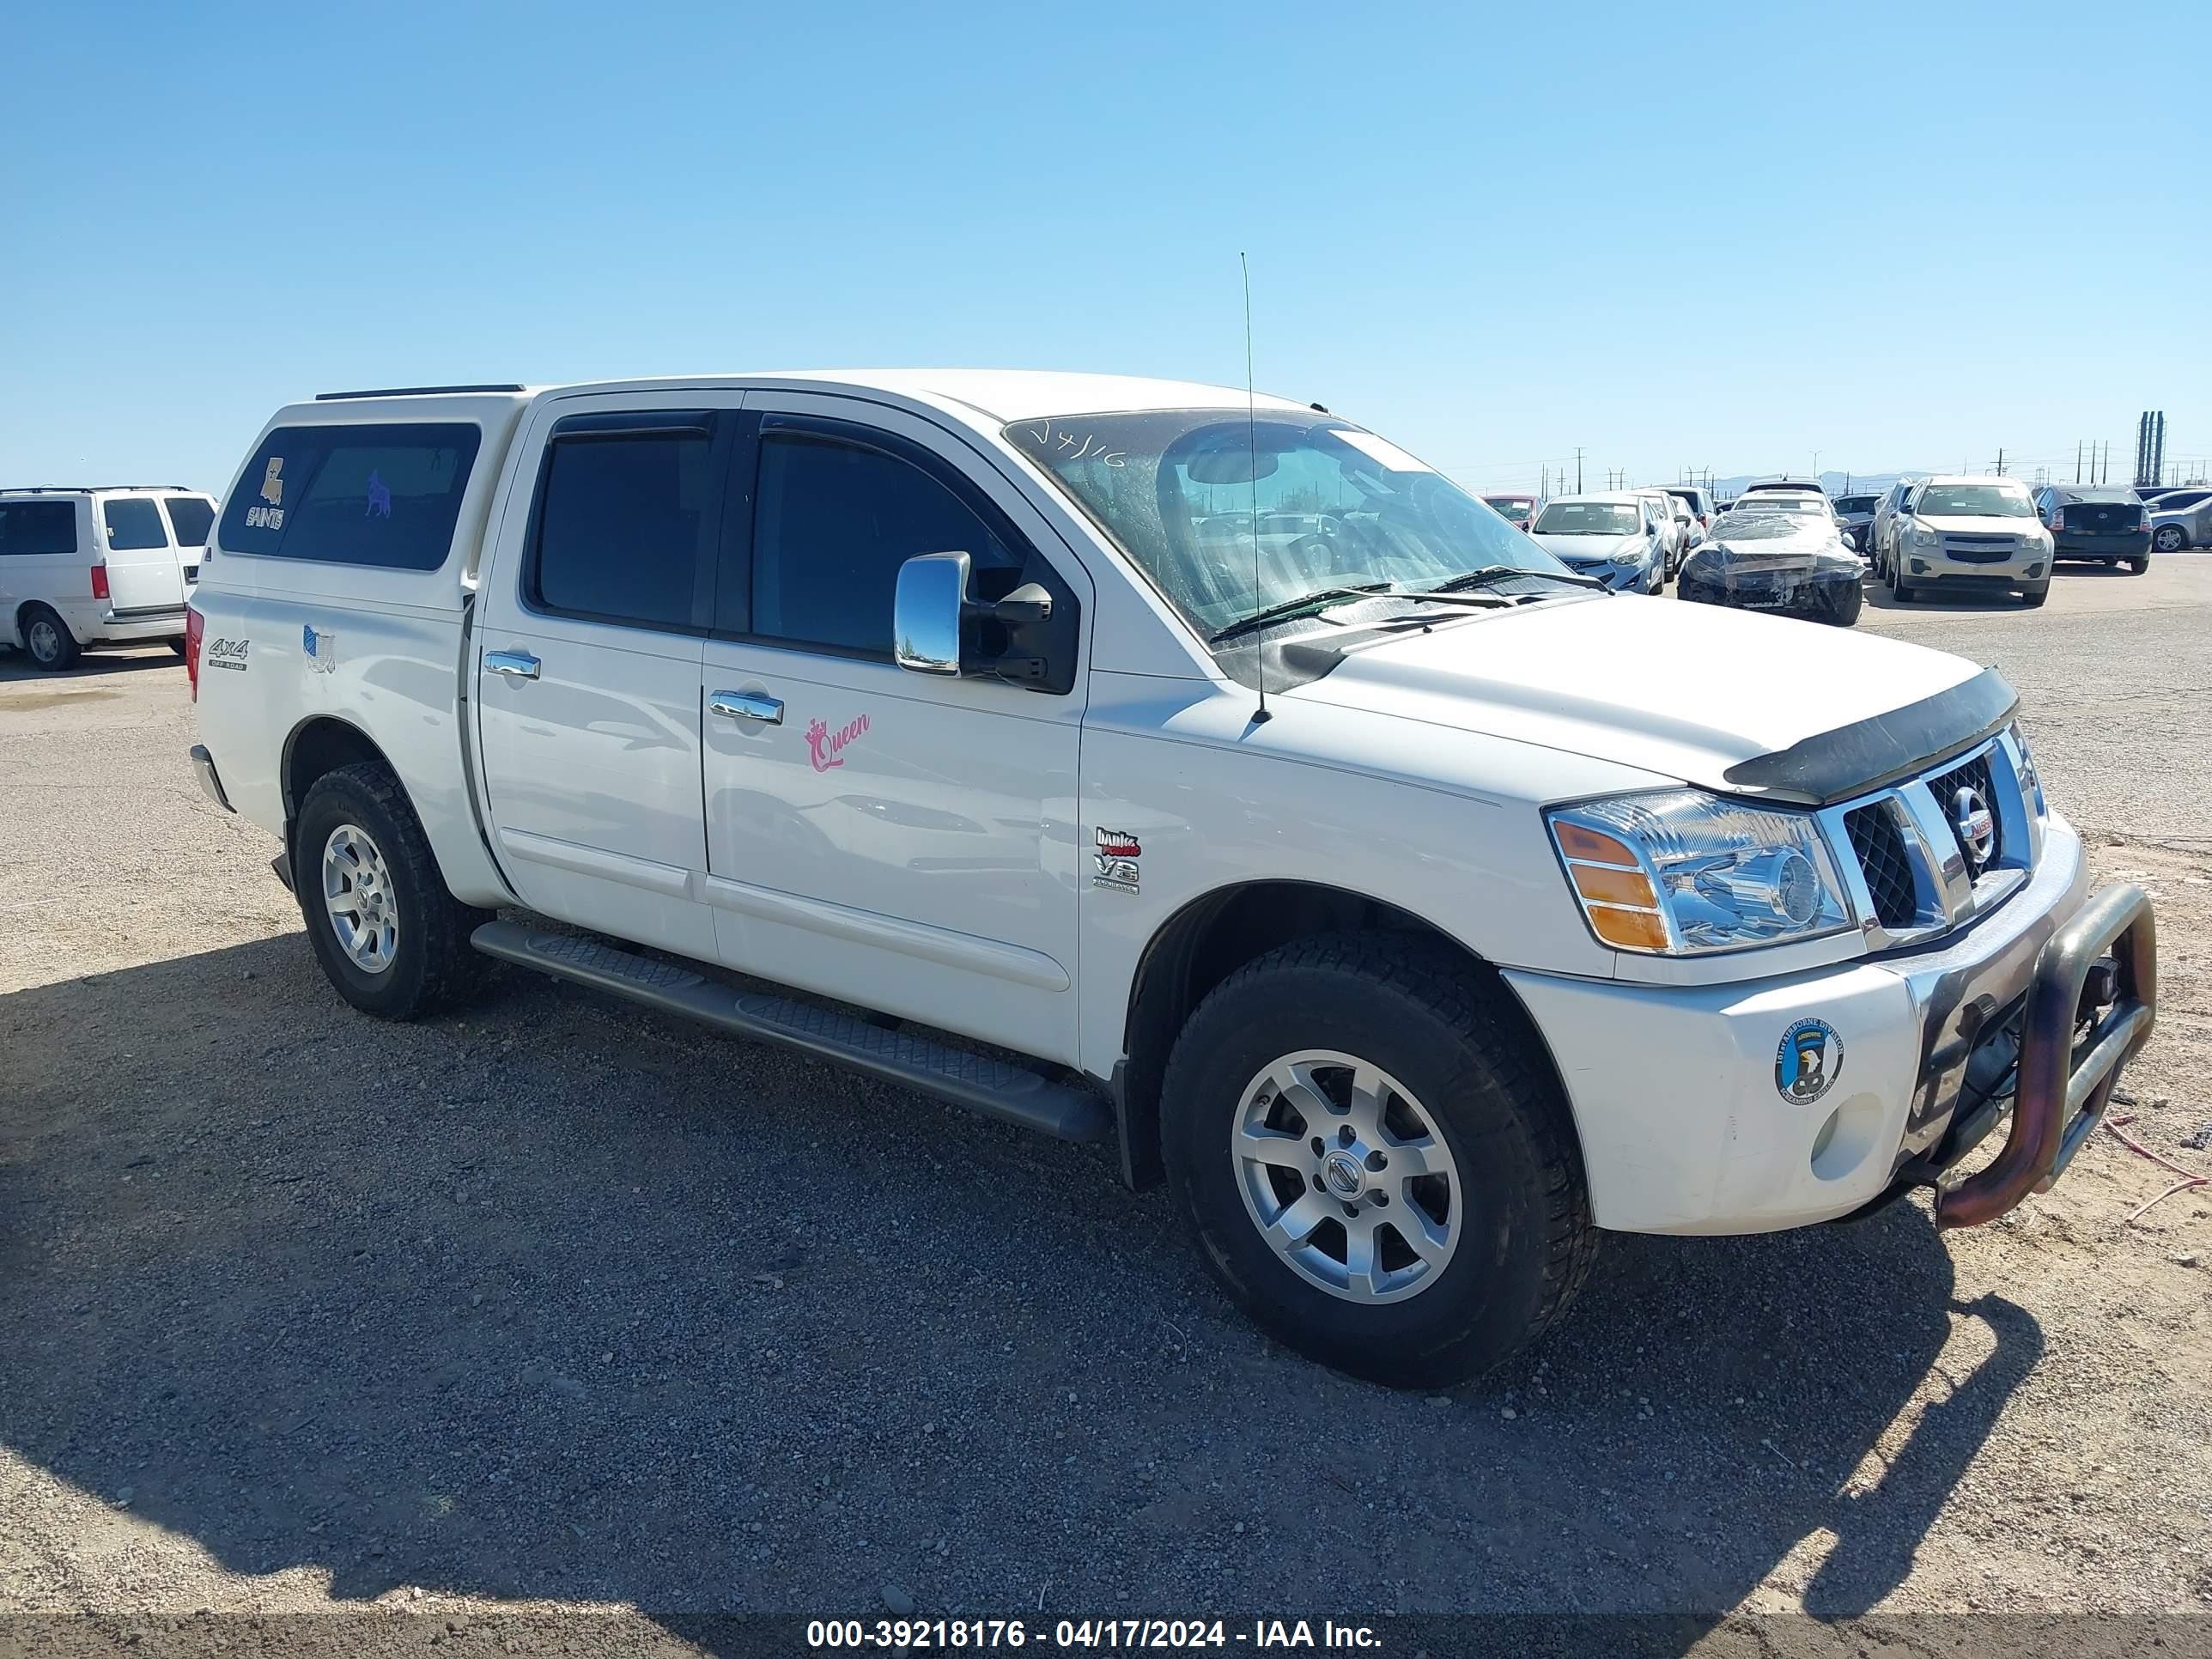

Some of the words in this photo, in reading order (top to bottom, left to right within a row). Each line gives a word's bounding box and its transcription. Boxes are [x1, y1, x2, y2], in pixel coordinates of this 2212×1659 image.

[246, 507, 284, 530] SAINTS
[208, 638, 250, 659] 4x4
[810, 714, 871, 773] Queen
[1093, 854, 1139, 883] V8
[1784, 1018, 1819, 1043] AIRBORNE
[1819, 1020, 1844, 1055] DIVISION
